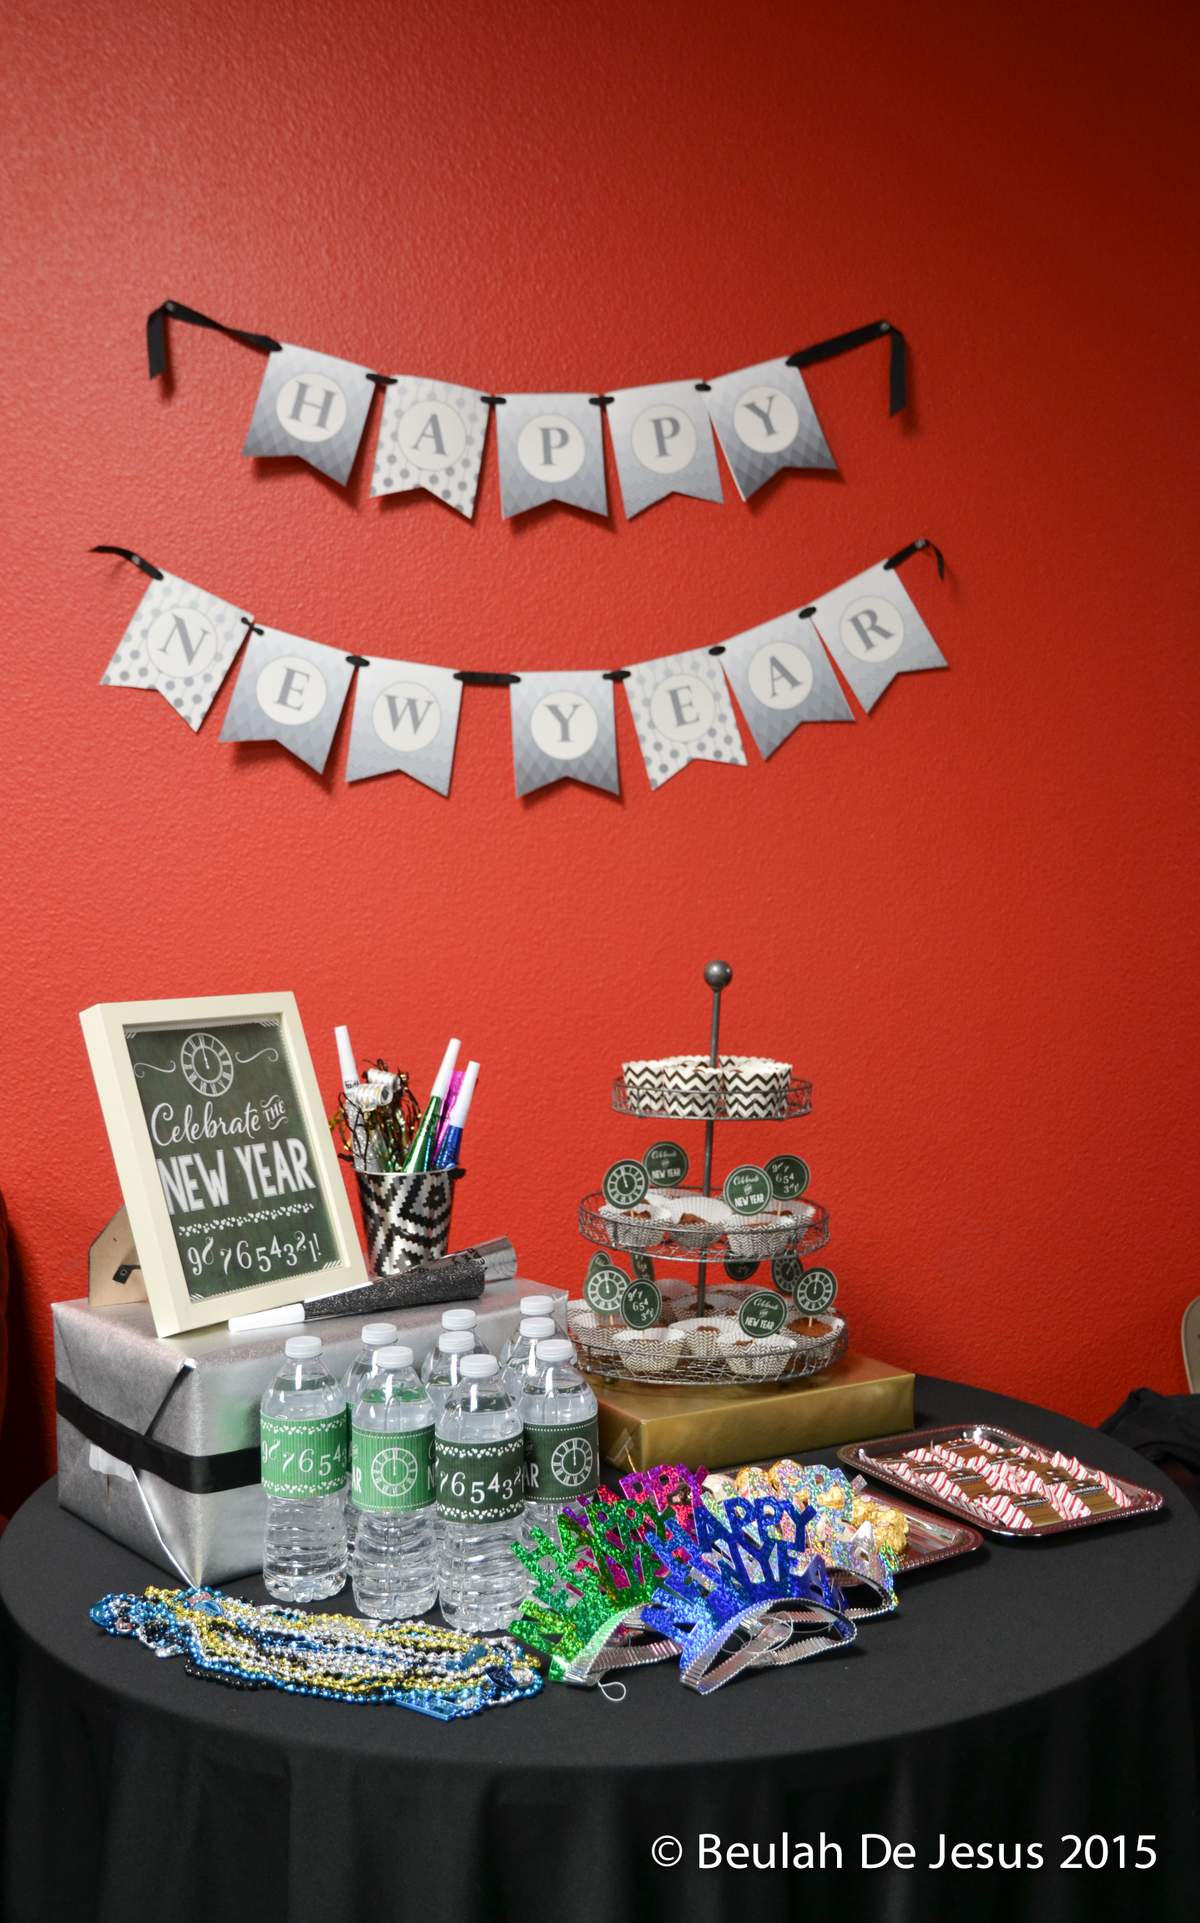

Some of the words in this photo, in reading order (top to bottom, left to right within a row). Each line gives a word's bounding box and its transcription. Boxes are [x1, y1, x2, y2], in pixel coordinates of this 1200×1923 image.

[287, 380, 783, 467] HAPPY
[156, 613, 433, 734] NEW
[547, 607, 895, 743] YEAR
[151, 1101, 260, 1146] Celebrate
[263, 1100, 286, 1122] THE
[155, 1149, 230, 1215] NEW
[233, 1138, 316, 1200] YEAR
[734, 1195, 749, 1207] NEW
[750, 1193, 765, 1205] YEAR
[745, 1316, 759, 1328] NEW
[760, 1319, 775, 1330] YEAR
